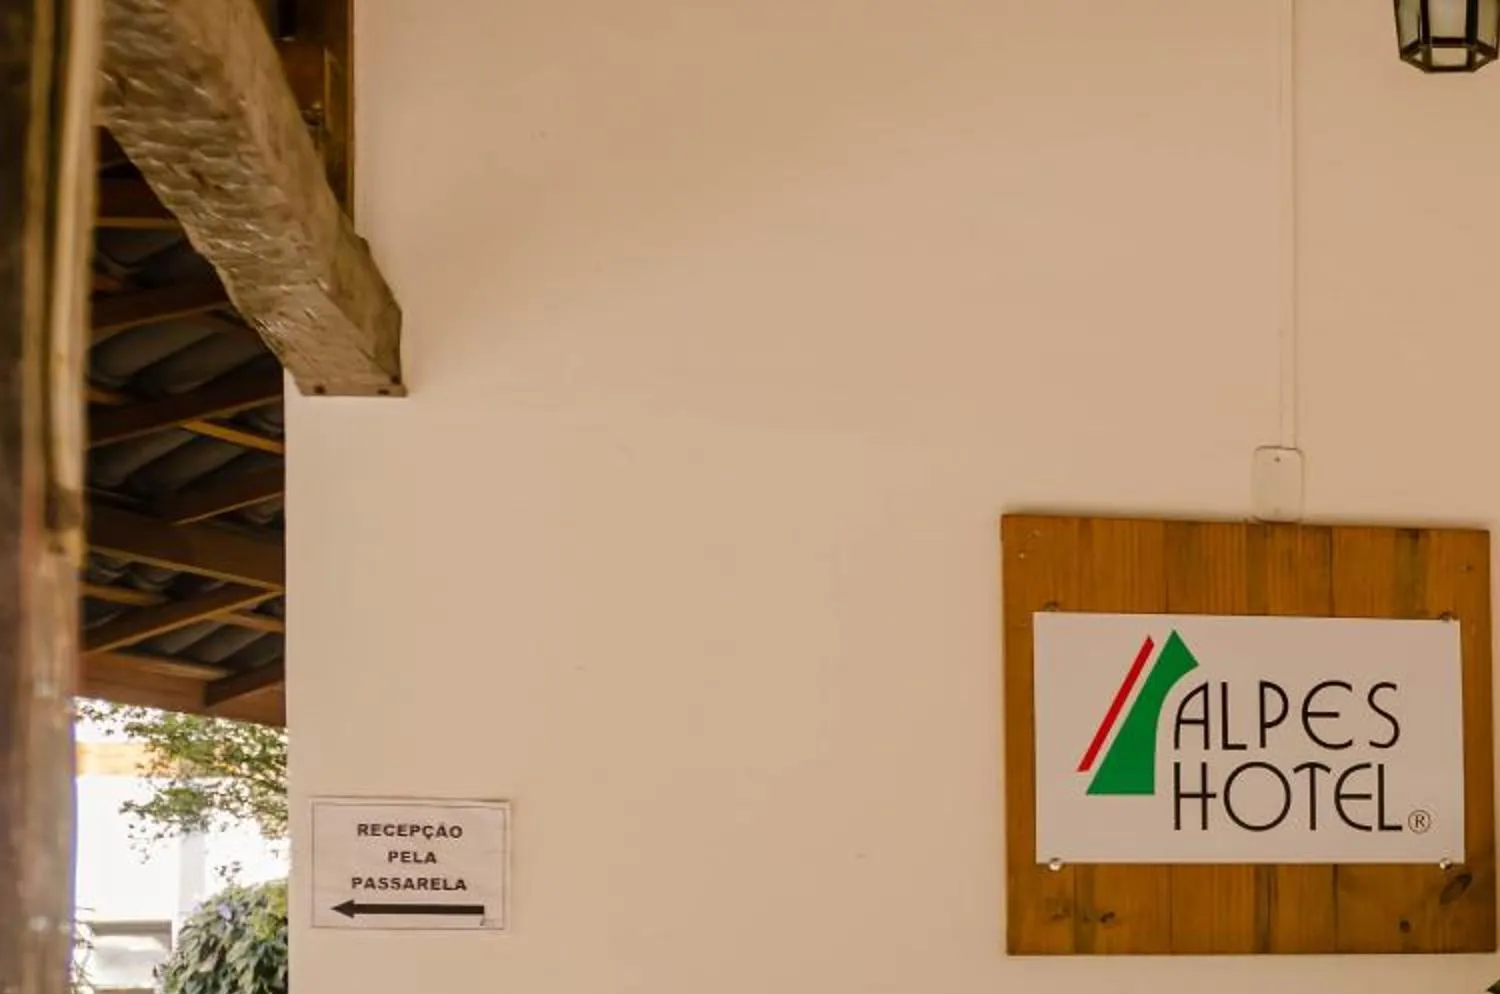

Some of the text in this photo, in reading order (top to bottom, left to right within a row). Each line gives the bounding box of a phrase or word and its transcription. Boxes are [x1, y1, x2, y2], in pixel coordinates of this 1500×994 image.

[1173, 680, 1400, 751] ALPES
[1173, 761, 1403, 832] HOTEL
[387, 851, 437, 864] PELA
[351, 877, 467, 891] PASSARELA
